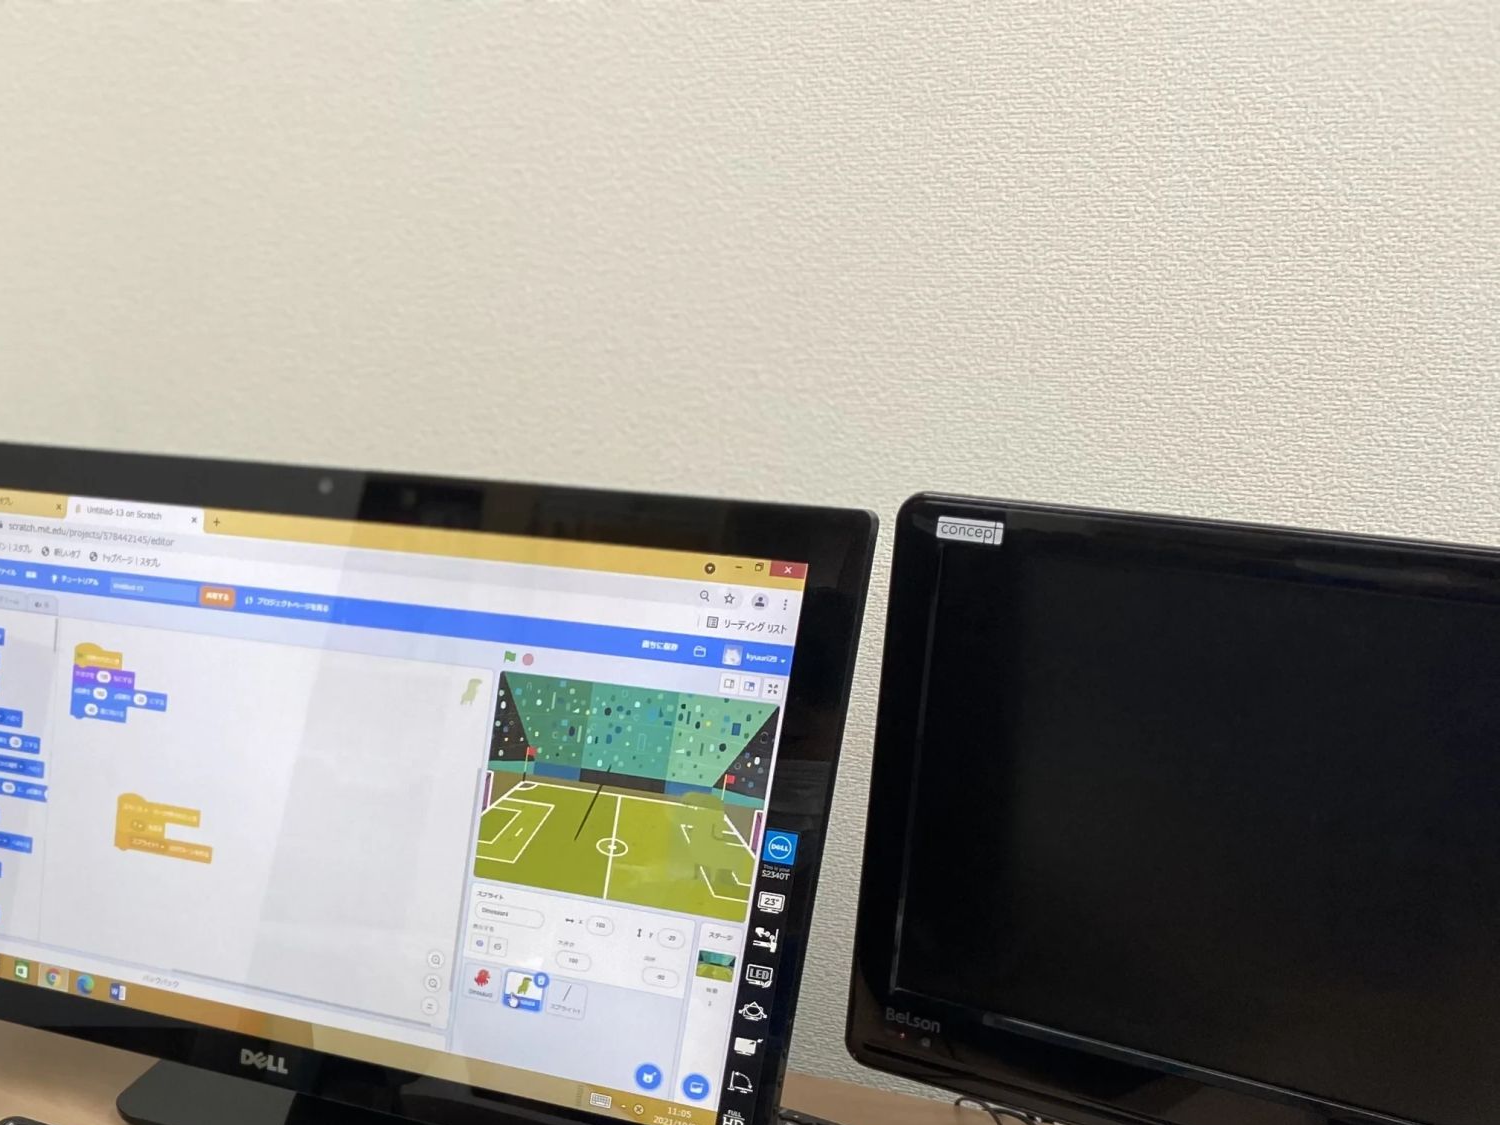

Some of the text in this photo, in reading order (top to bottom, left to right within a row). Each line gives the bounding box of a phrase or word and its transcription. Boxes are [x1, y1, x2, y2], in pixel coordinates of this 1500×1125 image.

[136, 509, 162, 521] Scratch
[761, 869, 791, 881] S2340T
[749, 968, 770, 981] LED
[240, 1048, 288, 1075] DELL
[667, 1106, 692, 1119] 11:05
